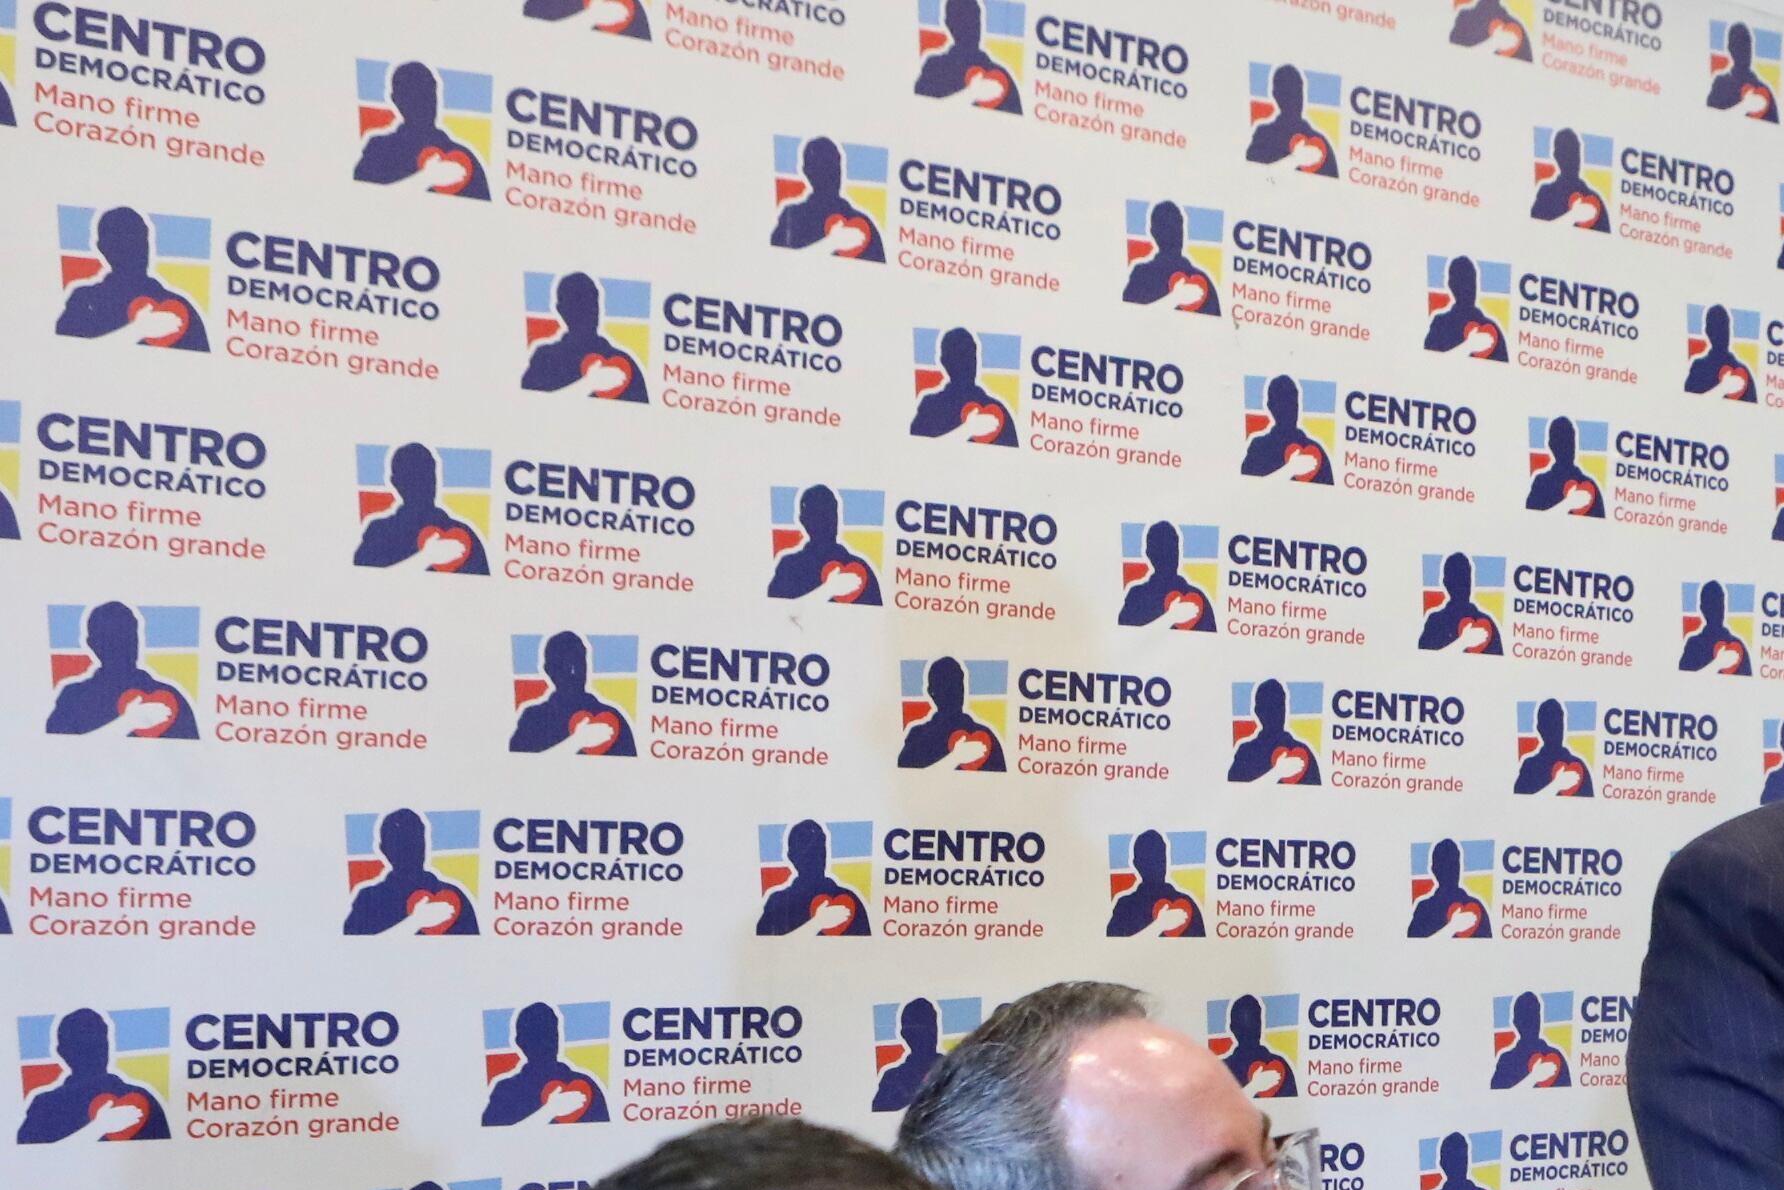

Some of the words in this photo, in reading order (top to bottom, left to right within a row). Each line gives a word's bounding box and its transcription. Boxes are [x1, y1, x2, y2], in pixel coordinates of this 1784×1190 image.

[33, 1, 266, 76] CENTRO
[1035, 15, 1189, 76] CENTRO
[35, 47, 265, 106] DEMOCRÁTICO
[1036, 52, 1187, 100] DEMOCRÁTICO
[35, 82, 115, 115] Mano
[126, 97, 199, 128] firme
[1036, 80, 1088, 106] Mano
[1095, 92, 1143, 117] firme
[506, 87, 698, 152] CENTRO
[1034, 104, 1114, 134] Corazón
[1121, 125, 1186, 148] grande
[34, 111, 155, 149] Corazón
[166, 137, 264, 166] grande
[507, 129, 697, 179] DEMOCRÁTICO
[507, 160, 572, 189] Mano
[581, 172, 642, 200] firme
[899, 159, 1062, 217] CENTRO
[506, 187, 605, 219] Corazón
[614, 208, 696, 234] grande
[900, 198, 1061, 241] DEMOCRÁTICO
[900, 226, 954, 251] Mano
[962, 236, 1014, 261] firme
[226, 230, 440, 294] CENTRO
[898, 250, 982, 279] Corazón
[990, 269, 1059, 291] grande
[228, 276, 440, 322] DEMOCRÁTICO
[228, 308, 300, 336] Mano
[310, 318, 378, 346] firme
[663, 292, 843, 348] CENTRO
[226, 336, 338, 368] Corazón
[348, 356, 438, 380] grande
[664, 334, 842, 374] DEMOCRÁTICO
[664, 364, 725, 388] Mano
[733, 372, 790, 396] firme
[663, 389, 756, 416] Corazón
[764, 405, 840, 426] grande
[1345, 391, 1476, 436] CENTRO
[36, 412, 267, 471] CENTRO
[1346, 426, 1475, 458] DEMOCRÁTICO
[39, 459, 266, 500] DEMOCRÁTICO
[1345, 451, 1389, 472] Mano
[1396, 457, 1437, 477] firme
[1344, 473, 1412, 495] Corazón
[1418, 485, 1474, 503] grande
[39, 493, 117, 520] Mano
[128, 501, 201, 527] firme
[38, 522, 157, 551] Corazón
[168, 537, 265, 560] grande
[1513, 564, 1634, 603] CENTRO
[1514, 598, 1633, 623] DEMOCRÁTICO
[214, 616, 429, 664] CENTRO
[1514, 622, 1554, 640] Mano
[1560, 626, 1598, 644] firme
[1513, 642, 1575, 661] Corazón
[1581, 651, 1632, 666] grande
[216, 661, 428, 692] DEMOCRÁTICO
[1018, 668, 1172, 708] CENTRO
[216, 694, 289, 717] Mano
[299, 697, 367, 720] firme
[1019, 706, 1170, 731] DEMOCRÁTICO
[216, 721, 326, 745] Corazón
[336, 728, 427, 750] grande
[1604, 708, 1718, 742] CENTRO
[1019, 734, 1071, 753] Mano
[1078, 736, 1126, 755] firme
[1604, 740, 1717, 761] DEMOCRÁTICO
[1018, 756, 1097, 776] Corazón
[1104, 762, 1169, 780] grande
[1604, 764, 1642, 780] Mano
[1648, 766, 1683, 782] firme
[1603, 784, 1661, 800] Corazón
[1667, 788, 1715, 804] grande
[27, 805, 256, 849] CENTRO
[884, 828, 1045, 864] CENTRO
[30, 850, 256, 877] DEMOCRÁTICO
[885, 865, 1044, 887] DEMOCRÁTICO
[30, 887, 108, 908] Mano
[119, 887, 191, 908] firme
[884, 896, 939, 914] Mano
[947, 896, 998, 914] firme
[30, 914, 148, 936] Corazón
[159, 915, 256, 940] grande
[884, 919, 966, 937] Corazón
[974, 919, 1043, 940] grande
[1308, 997, 1441, 1028] CENTRO
[185, 1010, 400, 1052] CENTRO
[1309, 1029, 1440, 1050] DEMOCRÁTICO
[187, 1051, 399, 1080] DEMOCRÁTICO
[1309, 1060, 1353, 1075] Mano
[1360, 1058, 1402, 1074] firme
[188, 1092, 261, 1112] Mano
[270, 1089, 339, 1109] firme
[1308, 1079, 1376, 1096] Corazón
[1382, 1076, 1439, 1097] grande
[187, 1115, 298, 1139] Corazón
[308, 1111, 399, 1138] grande
[1510, 1130, 1628, 1162] CENTRO
[1510, 1160, 1627, 1182] DEMOCRÁTICO
